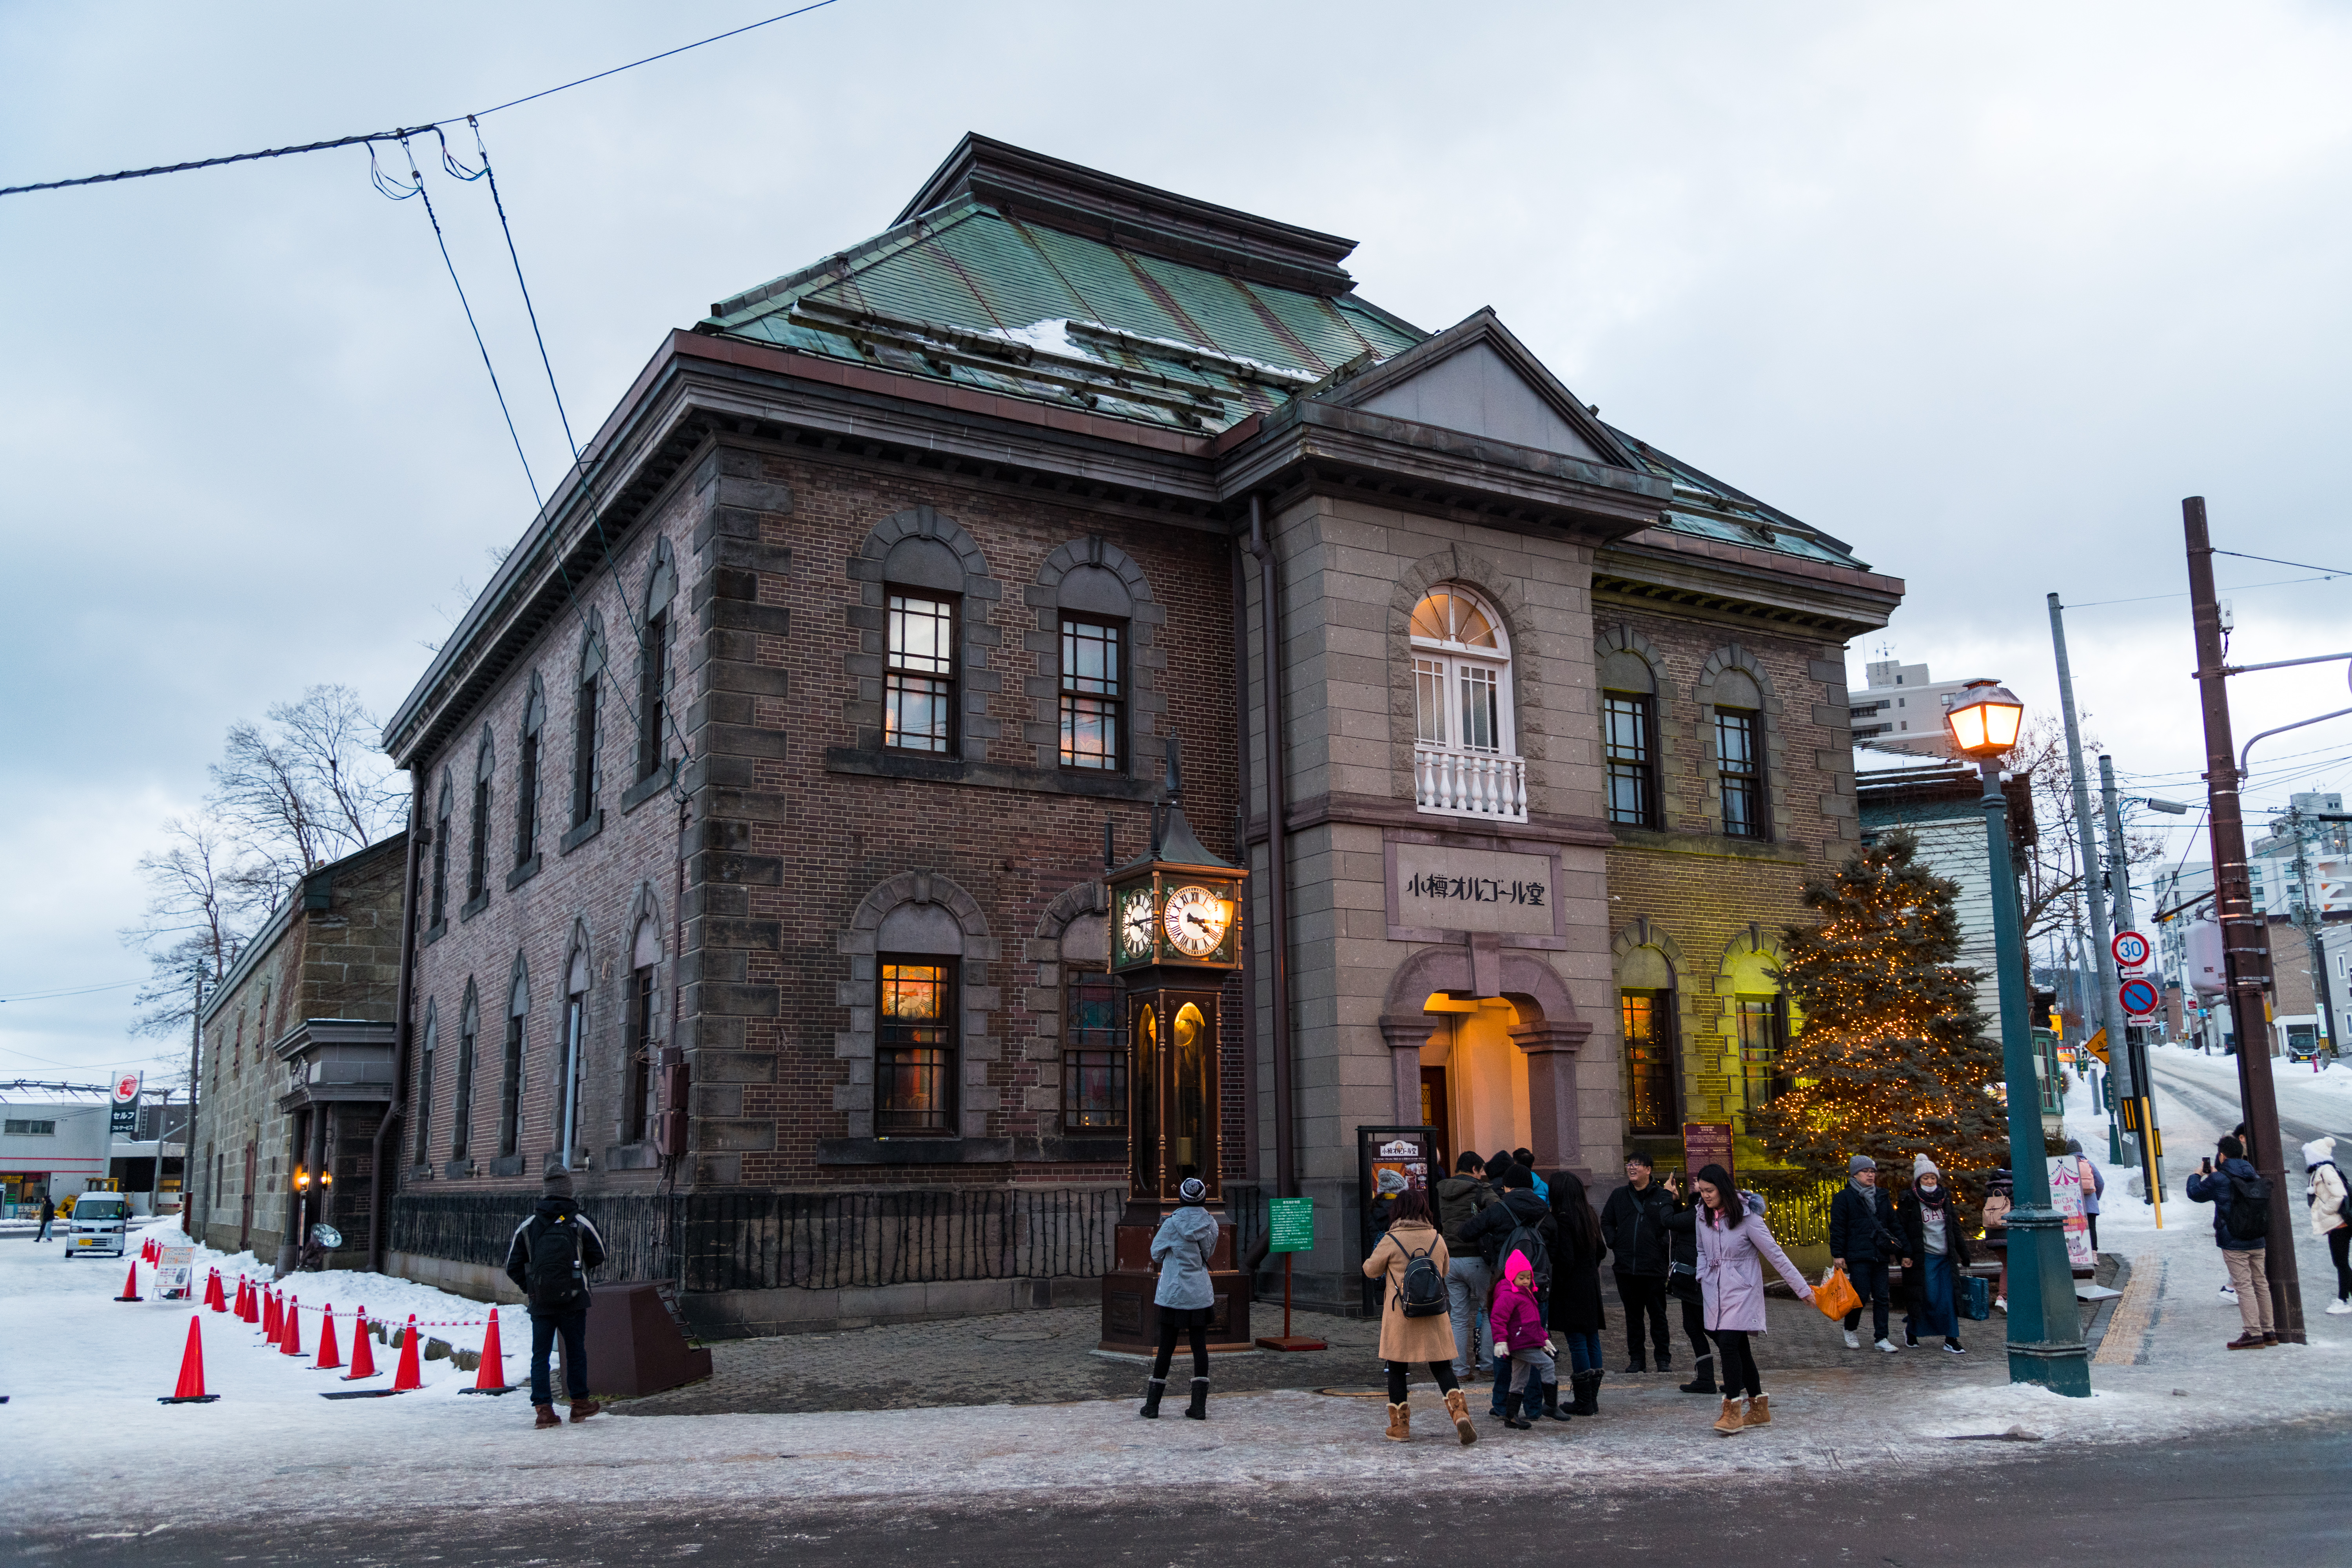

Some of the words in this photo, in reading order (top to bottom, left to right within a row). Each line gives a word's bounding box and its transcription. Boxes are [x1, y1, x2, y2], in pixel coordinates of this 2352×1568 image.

[1406, 872, 1544, 906] 小樽オルゴール堂
[2120, 941, 2141, 957] 30
